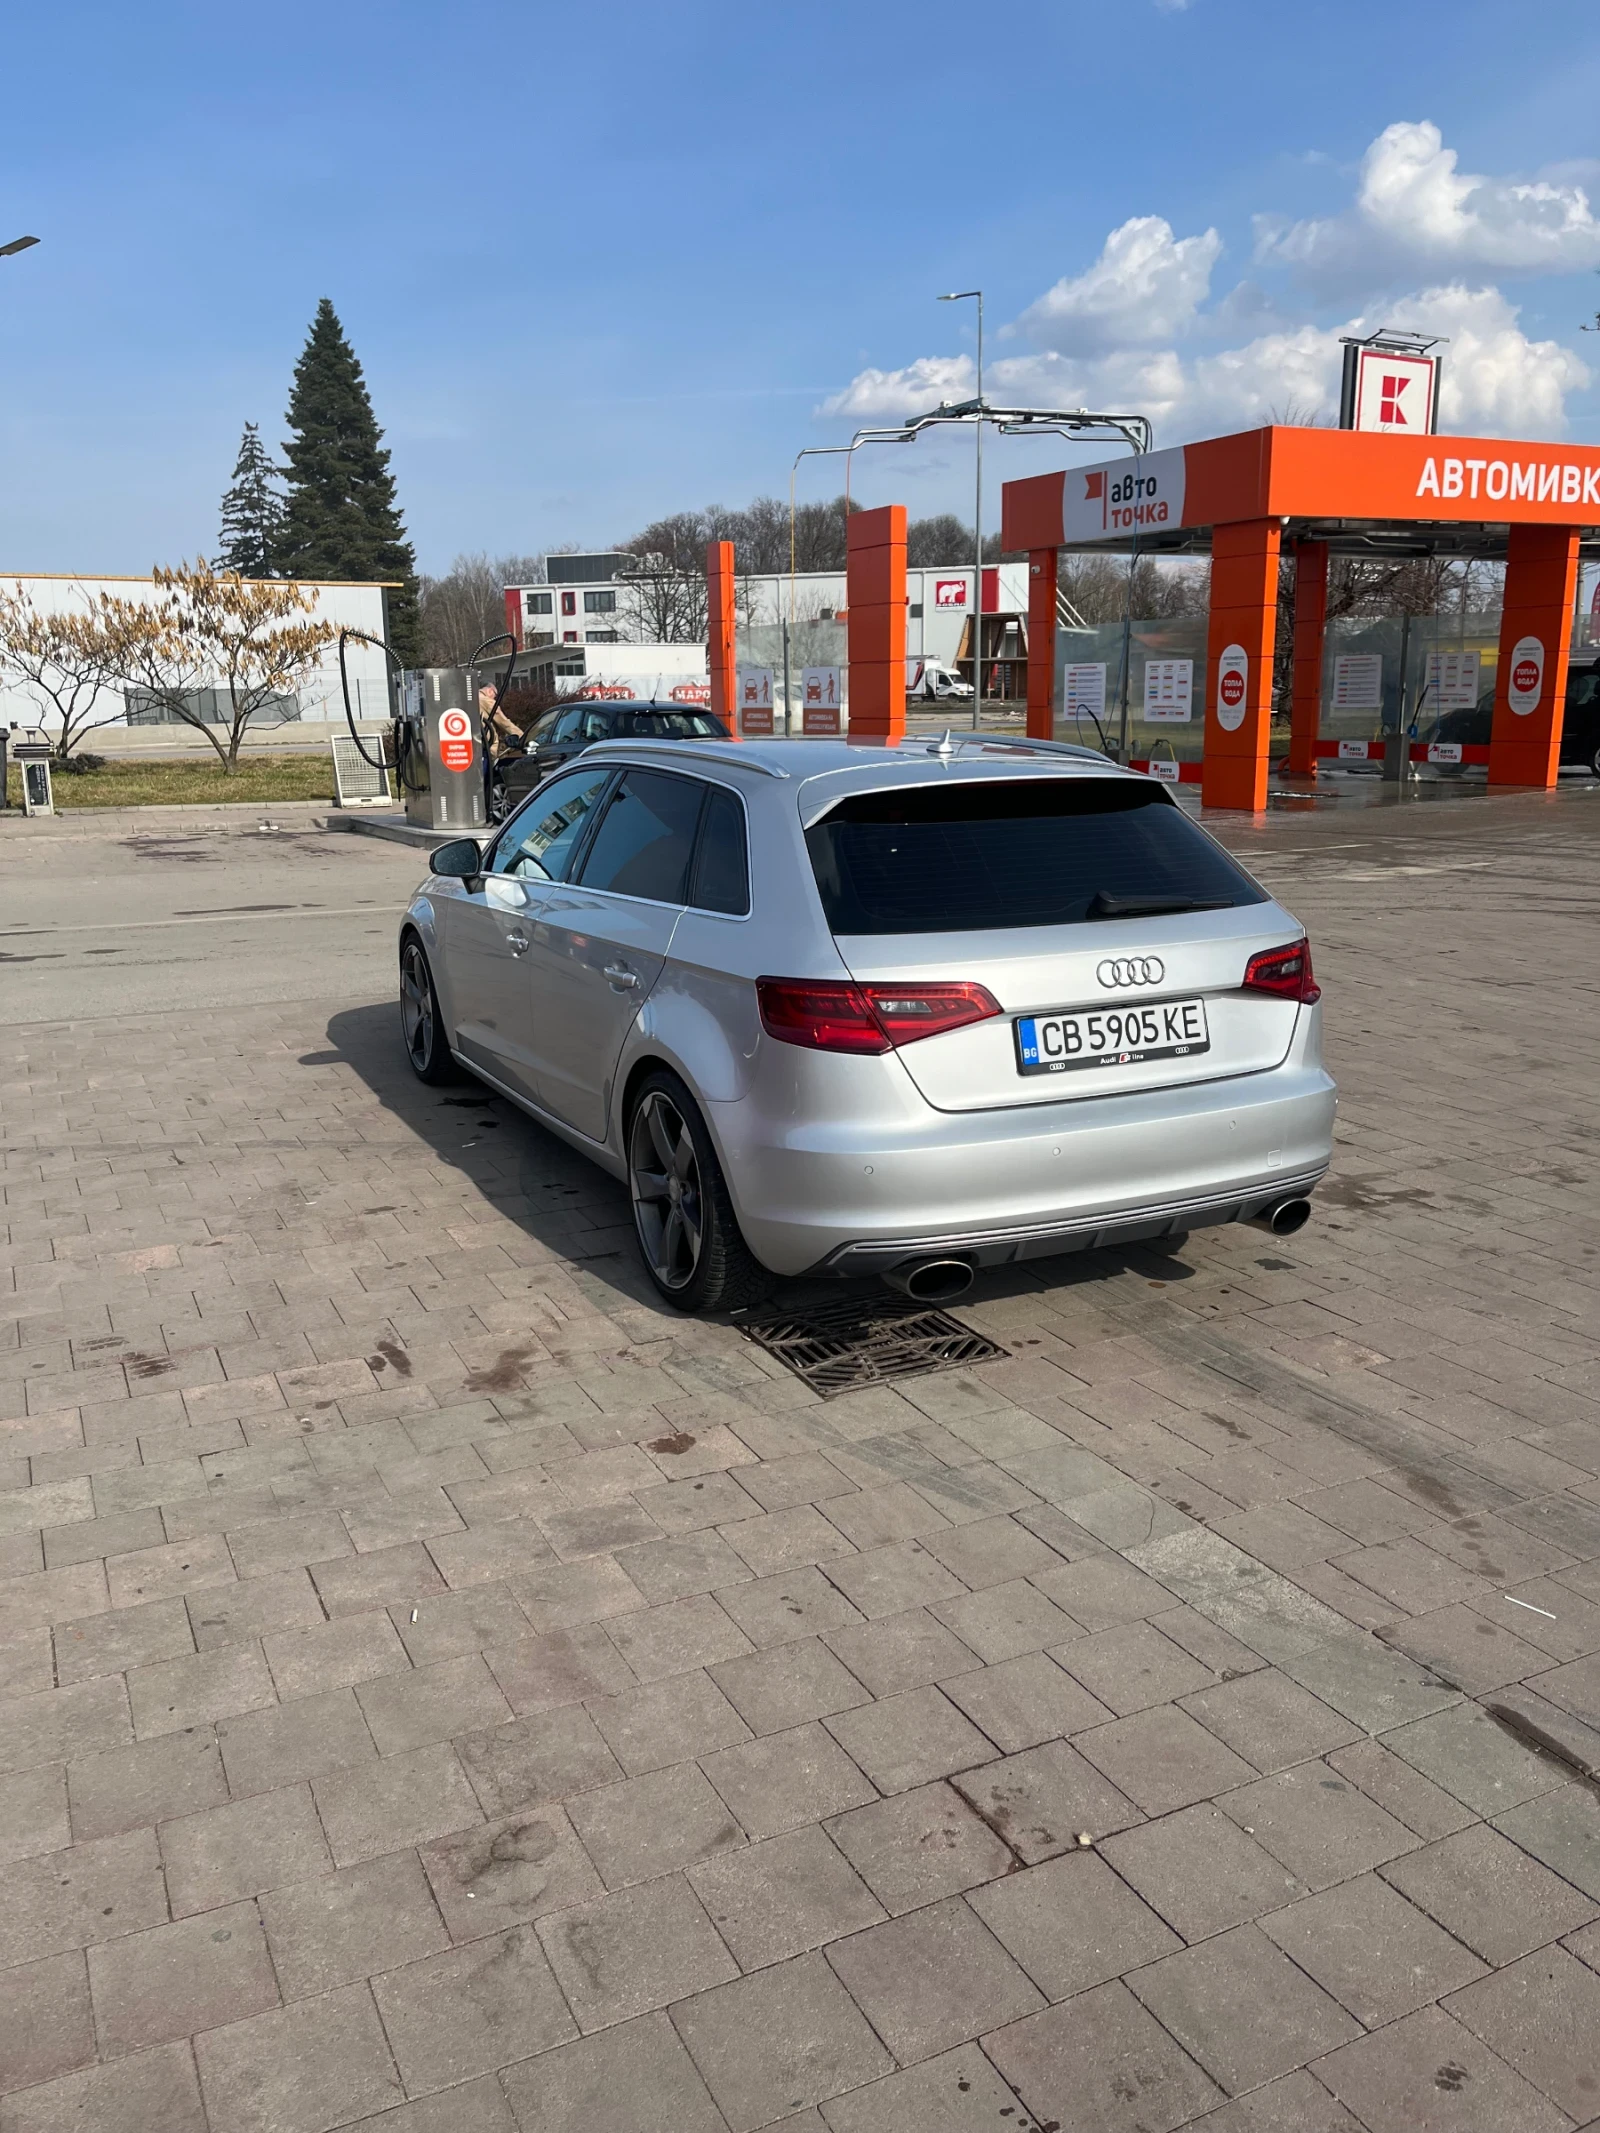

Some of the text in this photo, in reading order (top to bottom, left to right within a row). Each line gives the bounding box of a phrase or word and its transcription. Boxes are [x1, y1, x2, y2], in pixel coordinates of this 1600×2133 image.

[1415, 457, 1600, 505] АВТОМИВК
[1111, 501, 1169, 529] точка
[1516, 668, 1537, 676] ТОПЛА
[1517, 678, 1535, 686] ВОДА
[1225, 690, 1241, 698] ВОДА
[1023, 1047, 1038, 1059] BG
[1100, 1056, 1117, 1065] Audi
[1131, 1053, 1144, 1061] line
